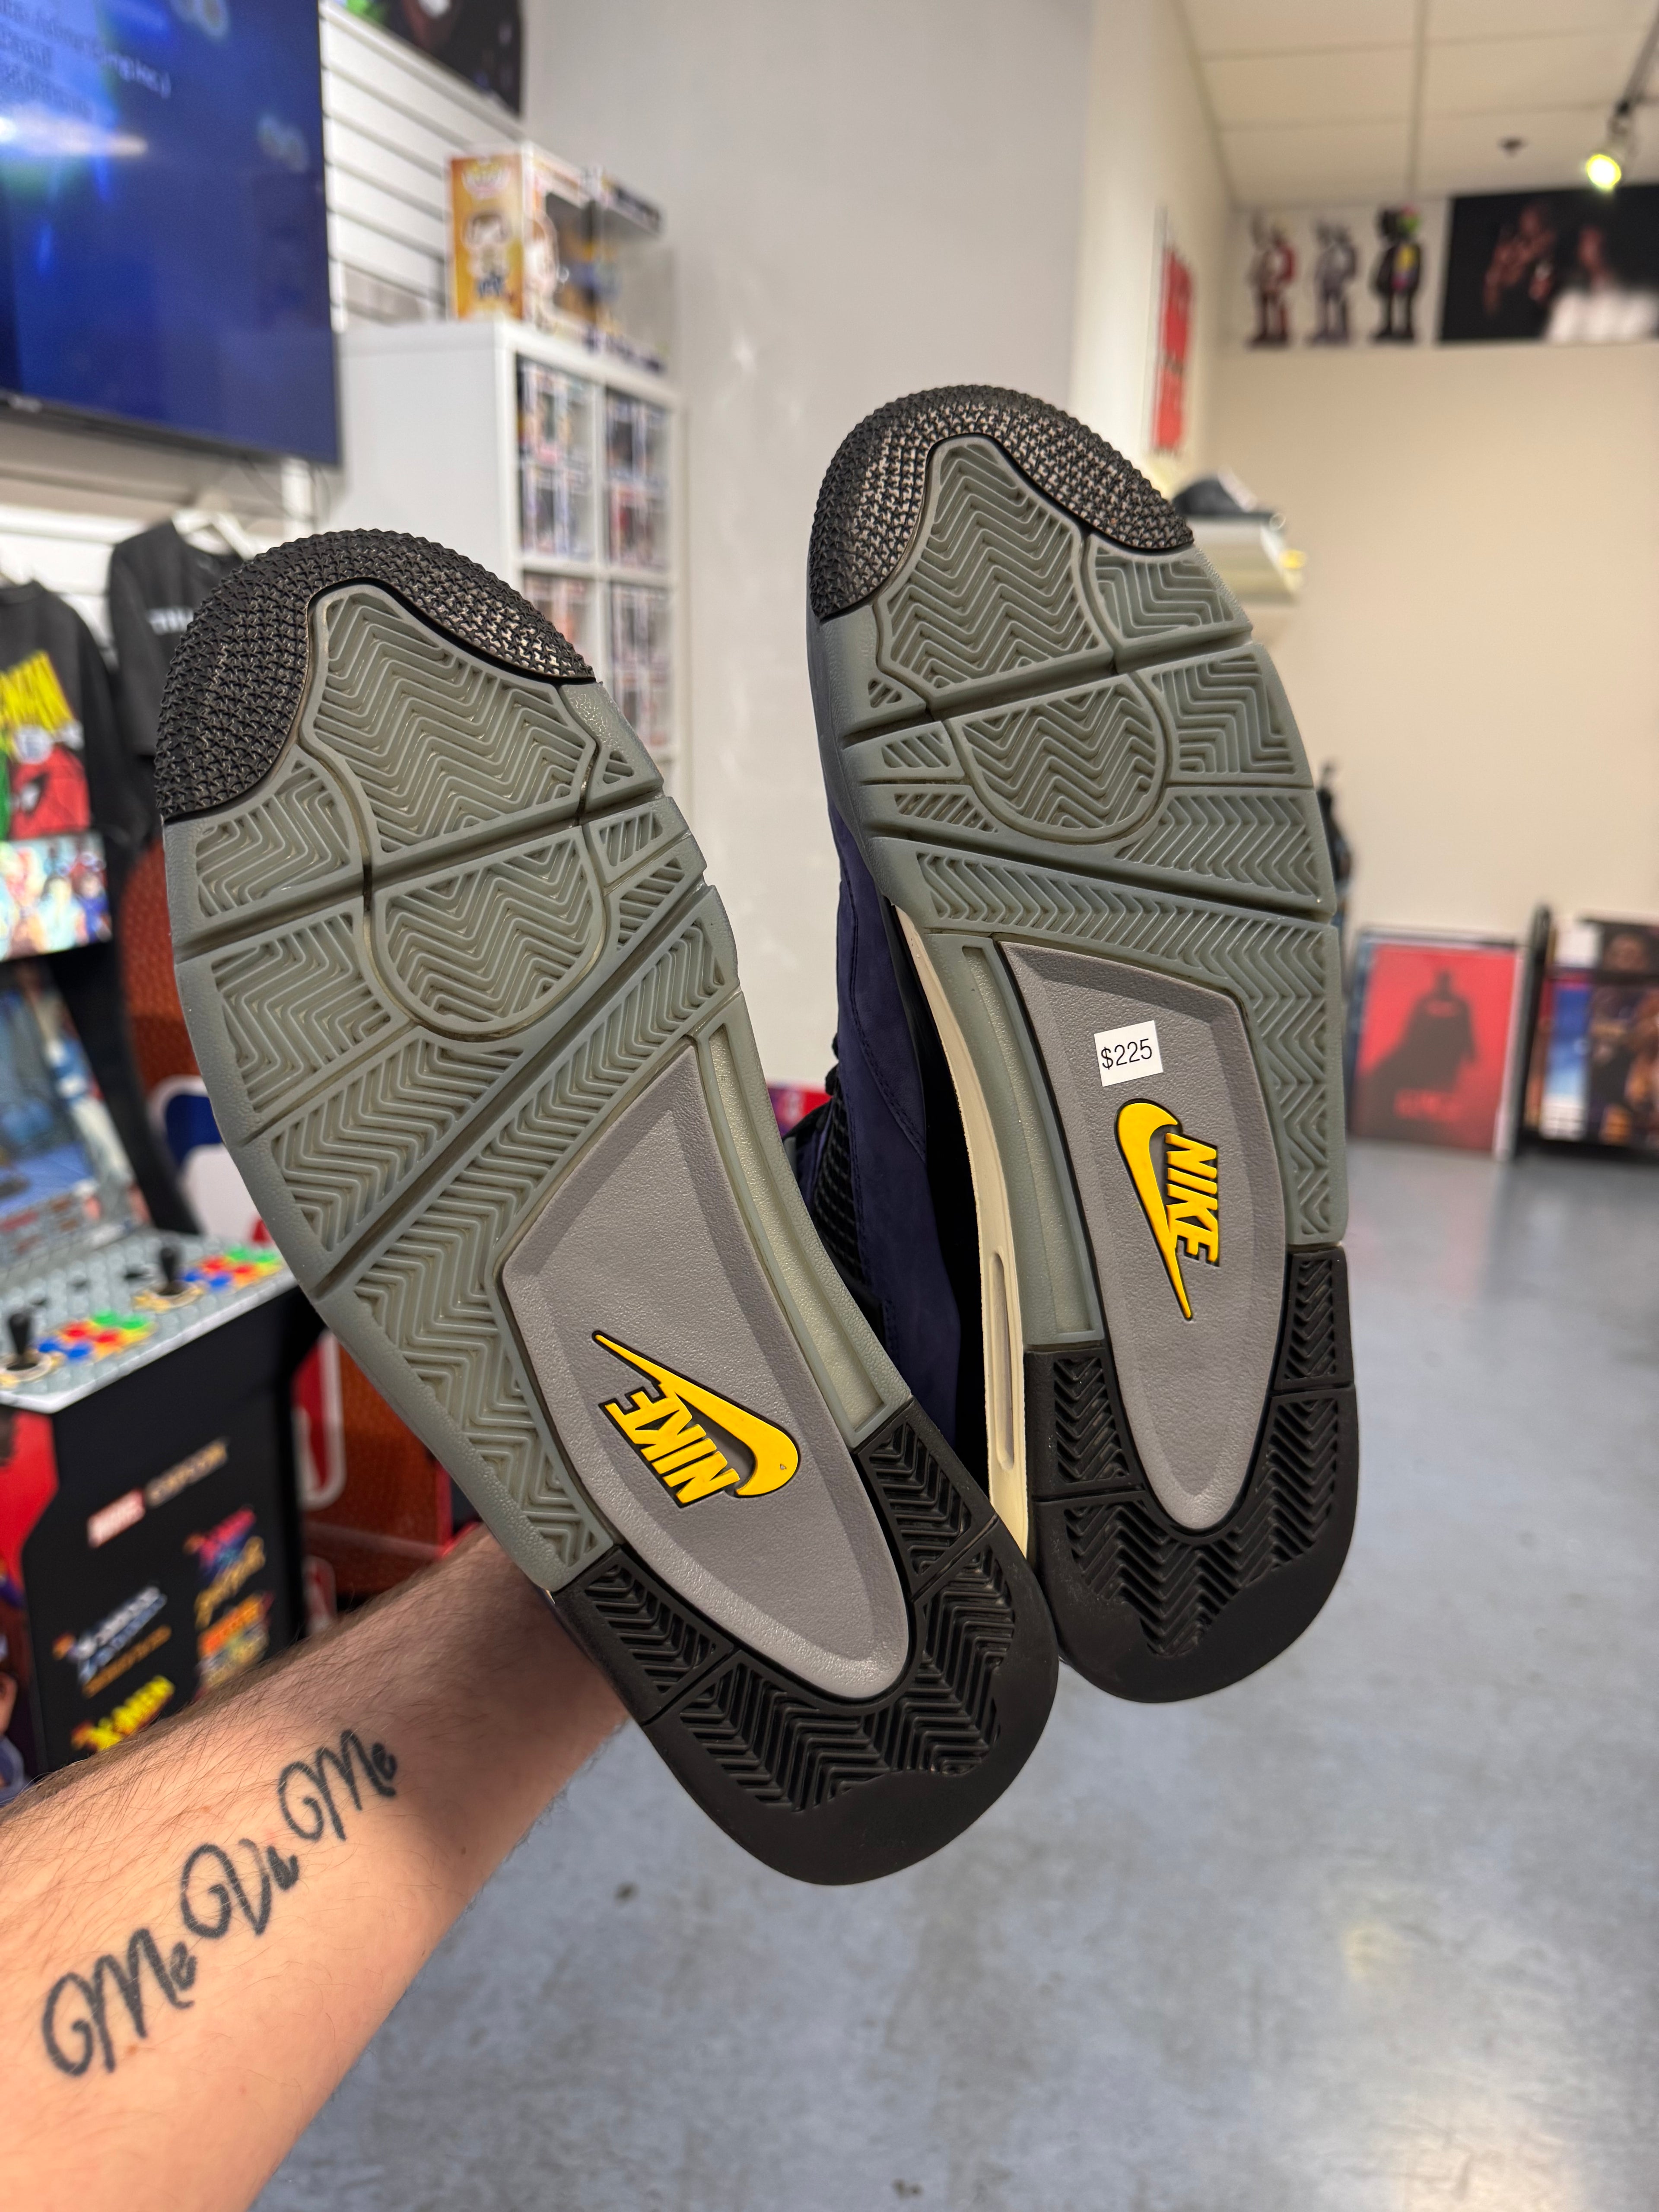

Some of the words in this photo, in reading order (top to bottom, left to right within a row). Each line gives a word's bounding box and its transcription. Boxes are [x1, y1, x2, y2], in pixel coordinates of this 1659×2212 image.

[1101, 1038, 1153, 1070] $225
[1165, 1132, 1218, 1263] NIKE
[604, 1382, 741, 1503] NIKE
[41, 1927, 198, 2076] Me
[277, 1729, 397, 1842] Me
